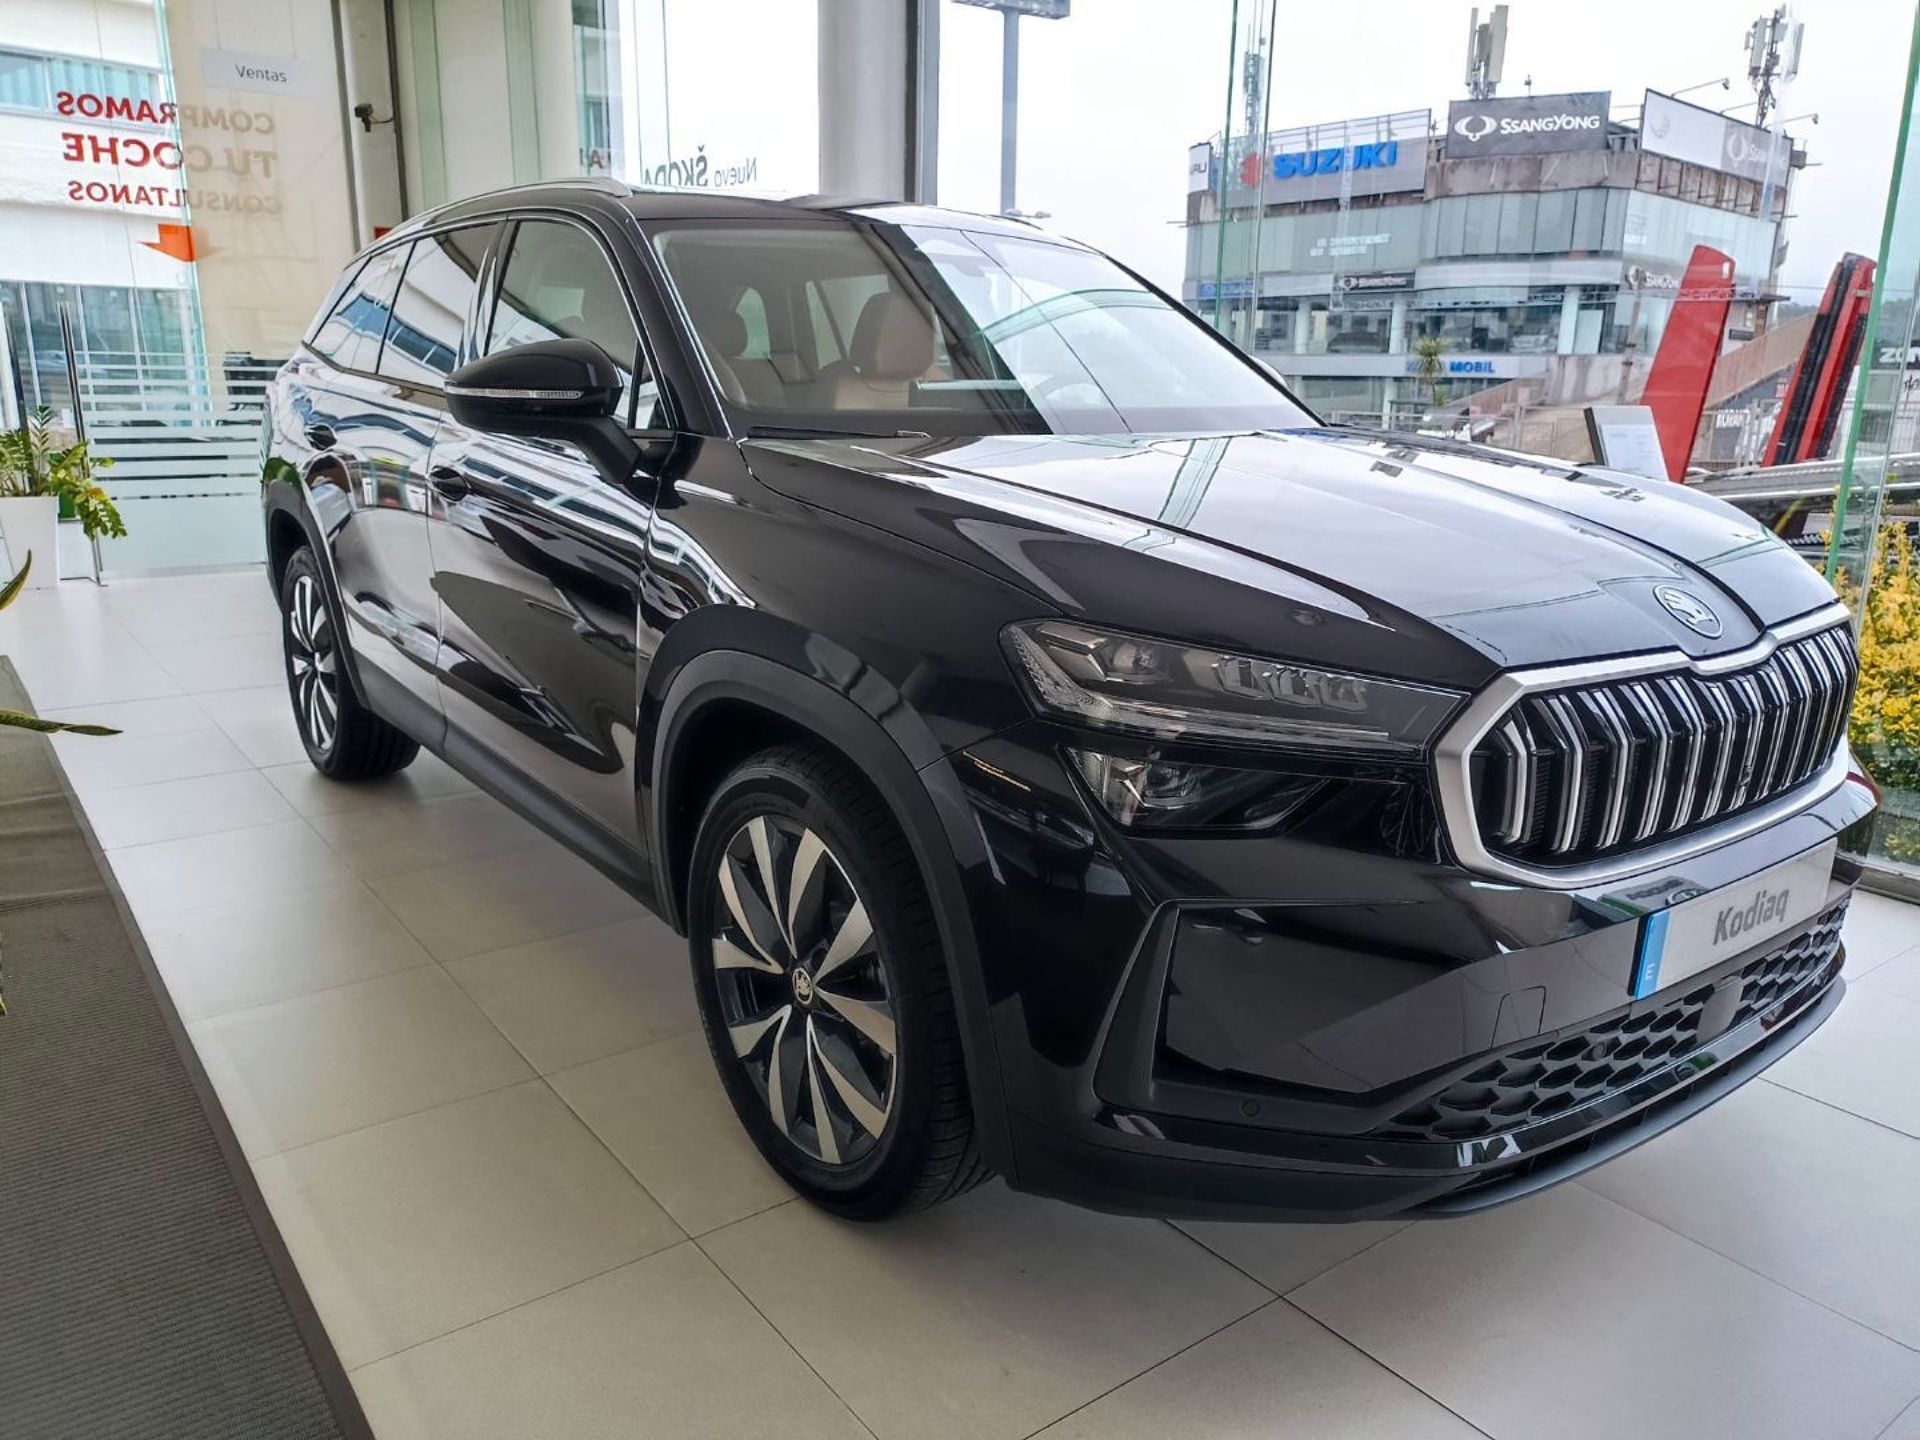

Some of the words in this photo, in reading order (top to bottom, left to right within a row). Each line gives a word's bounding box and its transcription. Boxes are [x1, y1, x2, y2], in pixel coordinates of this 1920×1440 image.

[235, 63, 288, 83] Ventas
[1274, 141, 1398, 179] SUZUKI
[1713, 889, 1790, 946] Kodiaq
